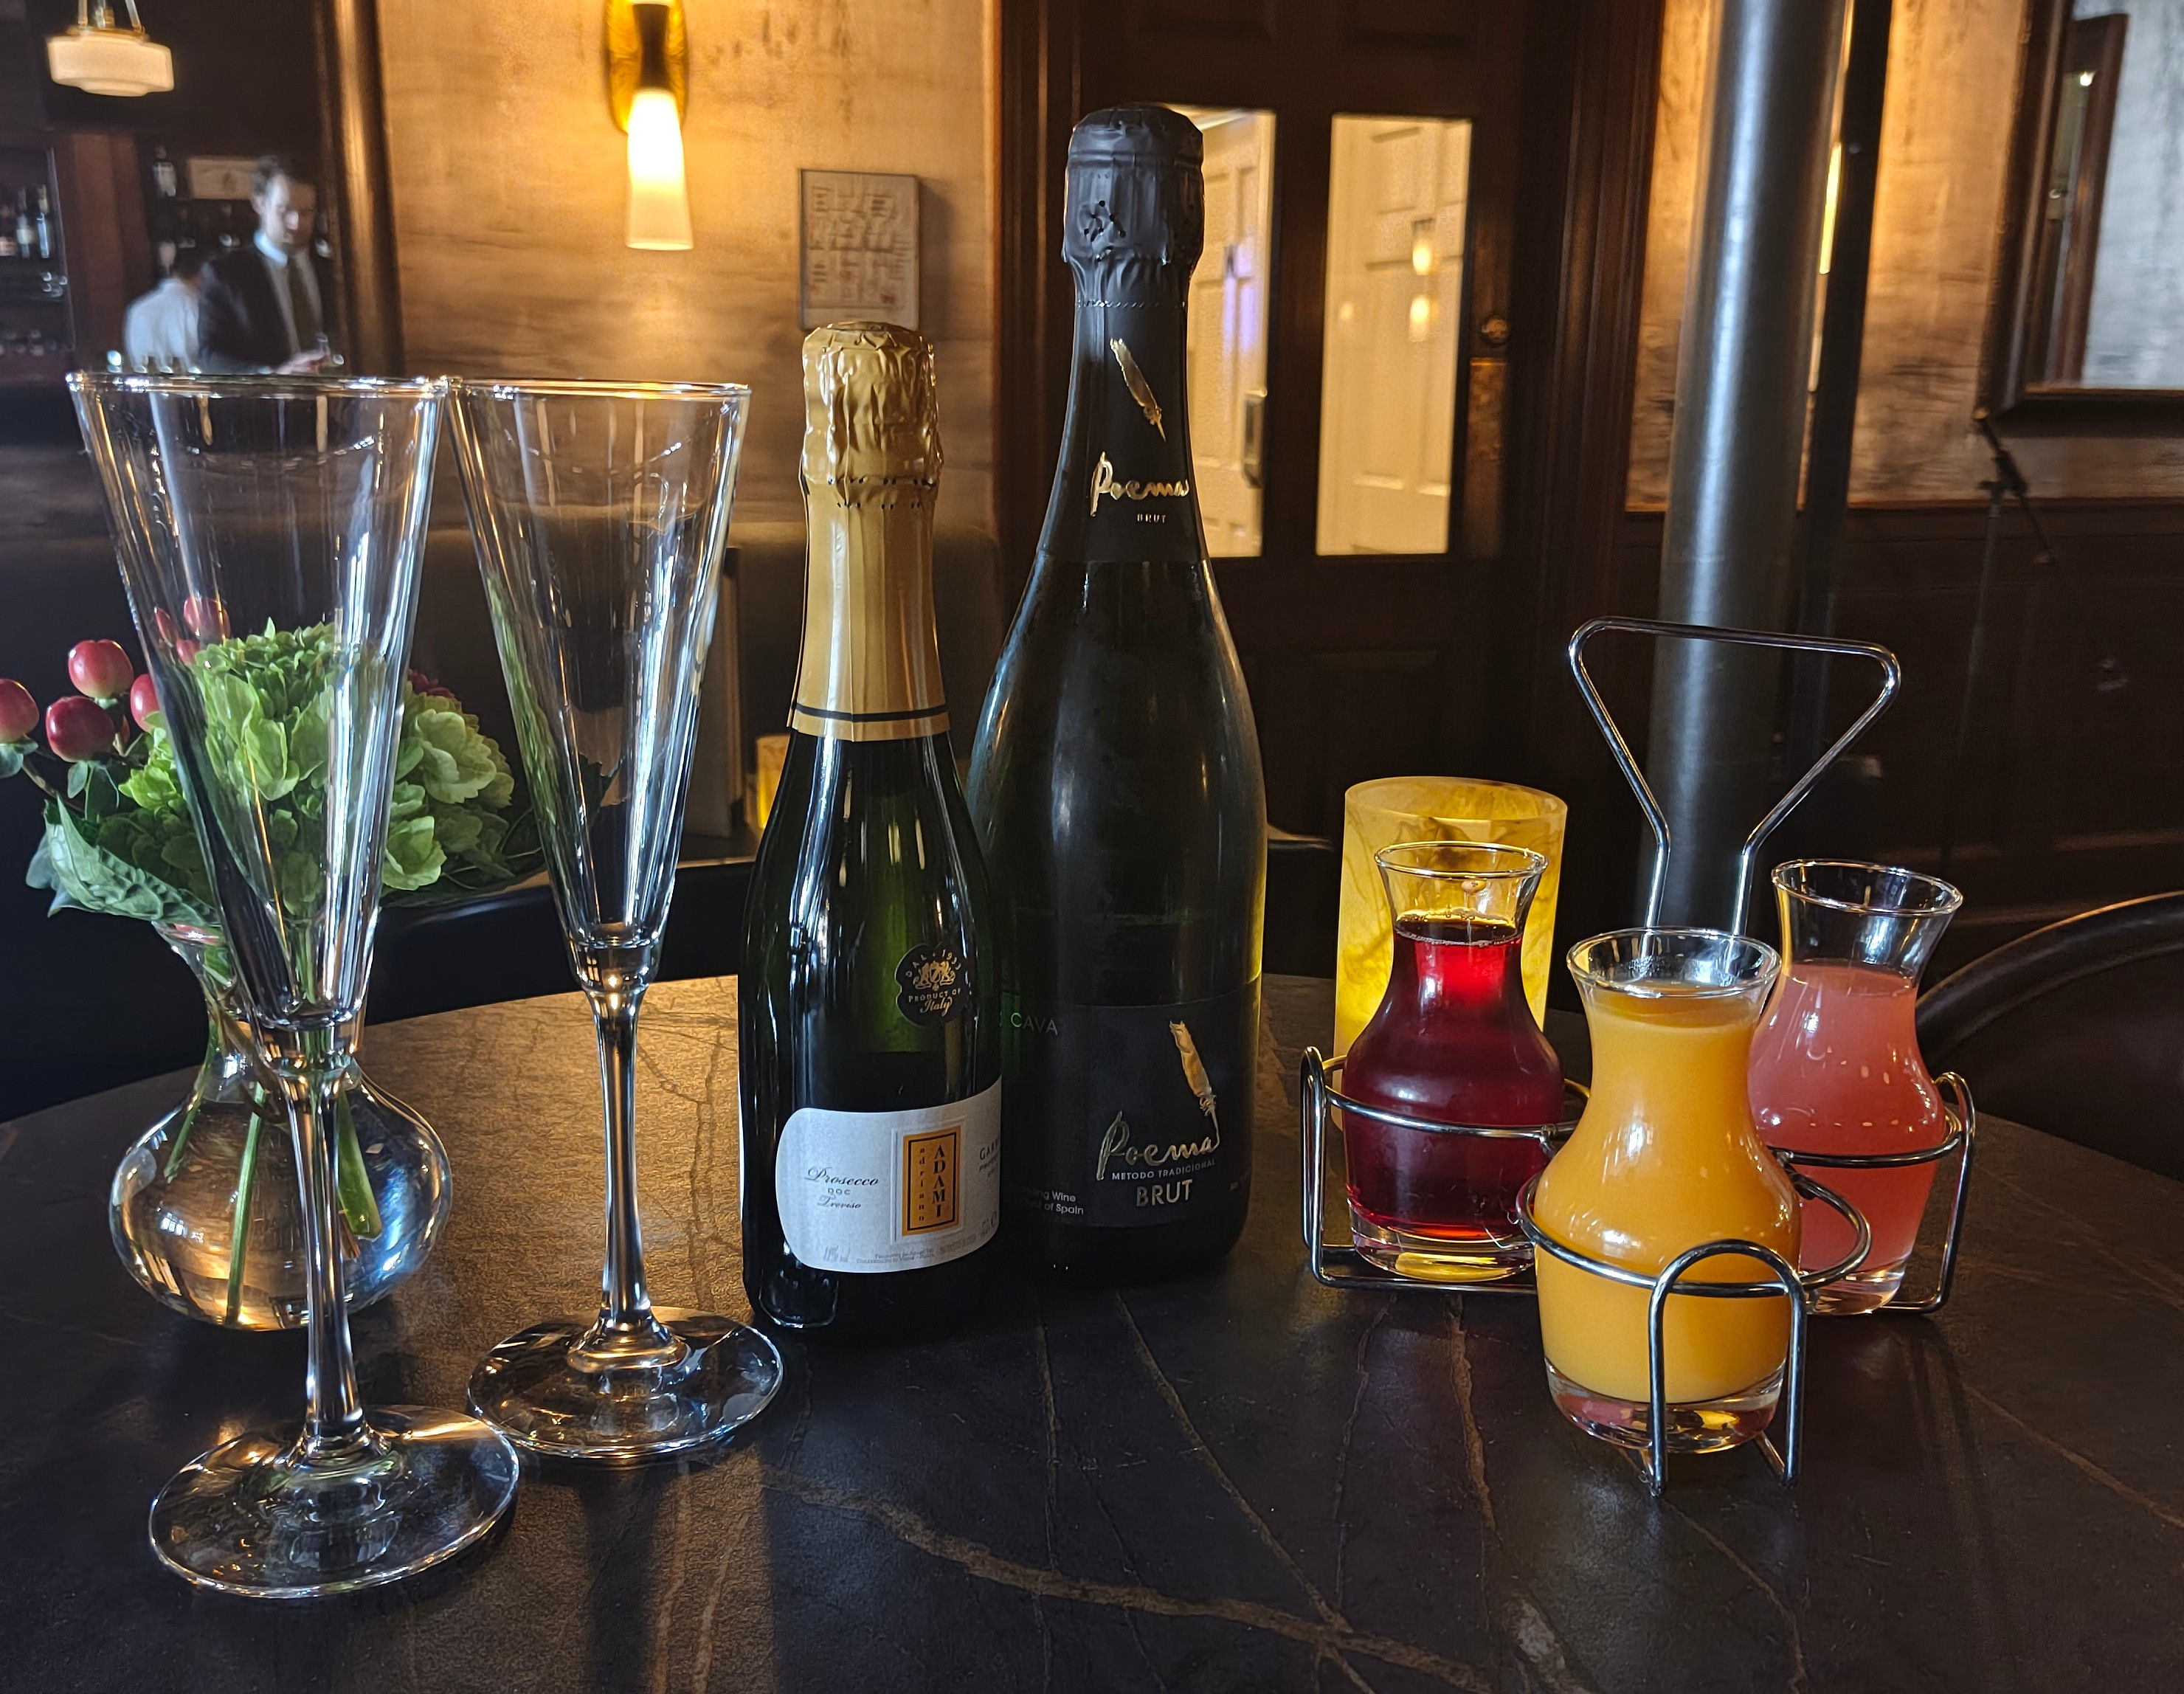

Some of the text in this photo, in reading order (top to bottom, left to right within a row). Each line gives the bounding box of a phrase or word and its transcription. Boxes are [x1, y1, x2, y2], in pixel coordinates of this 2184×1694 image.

[1090, 451, 1189, 517] Poema
[1137, 513, 1167, 524] BRUT
[919, 996, 953, 1017] Italy
[1010, 1012, 1058, 1036] CAVA
[1096, 1110, 1220, 1181] Poema
[804, 1166, 879, 1186] Prosecco
[1112, 1158, 1216, 1180] METODO TRADICIONAL
[828, 1187, 851, 1195] DOC
[933, 1143, 947, 1218] ADAMI
[1051, 1190, 1077, 1202] Wine
[1136, 1179, 1193, 1207] BRUT
[1044, 1203, 1054, 1211] of
[1056, 1203, 1084, 1215] Spain
